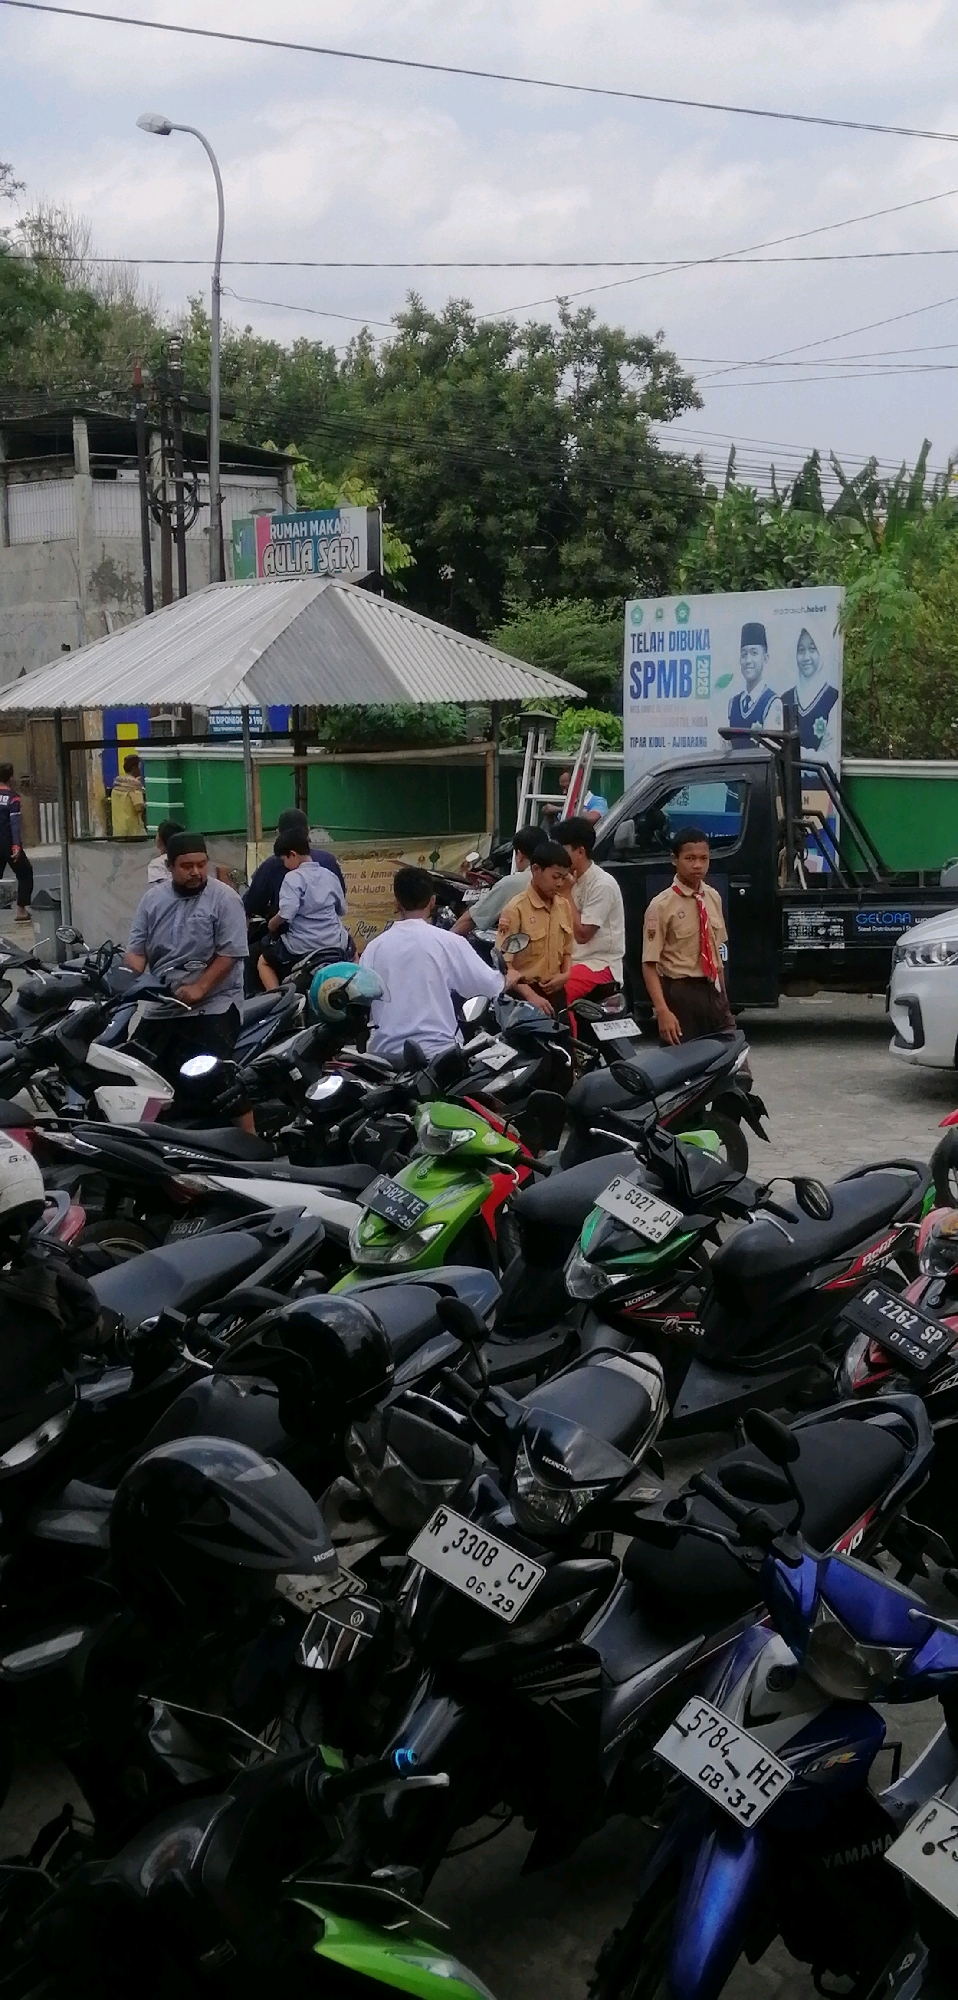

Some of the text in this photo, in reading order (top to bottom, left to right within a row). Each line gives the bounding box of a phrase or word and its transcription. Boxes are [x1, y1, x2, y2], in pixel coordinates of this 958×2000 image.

[269, 516, 351, 540] RUMAH MAKAN
[262, 536, 360, 577] AULIA SARI
[630, 628, 711, 654] TELAH DIBUKA
[629, 658, 693, 700] SPMB
[696, 658, 709, 697] 2026
[216, 715, 253, 725] DIPONEGOO
[629, 736, 647, 748] TIPAR
[648, 736, 667, 748] KIDUL
[672, 736, 708, 748] AJIBARANG
[360, 870, 367, 879] &
[350, 883, 386, 894] Al-Huda
[855, 911, 912, 925] GELORA
[372, 1178, 426, 1216] R 5824 TE
[607, 1178, 621, 1193] R
[623, 1188, 656, 1213] 6327
[623, 1289, 657, 1307] HONDA
[861, 1289, 944, 1345] R 2262 SP
[541, 1455, 574, 1476] HONDA
[429, 1512, 537, 1592] R 3308 CJ
[686, 1707, 740, 1759] 5784
[745, 1756, 785, 1799] HE
[914, 1808, 938, 1834] R
[821, 1833, 895, 1869] YAMAHA
